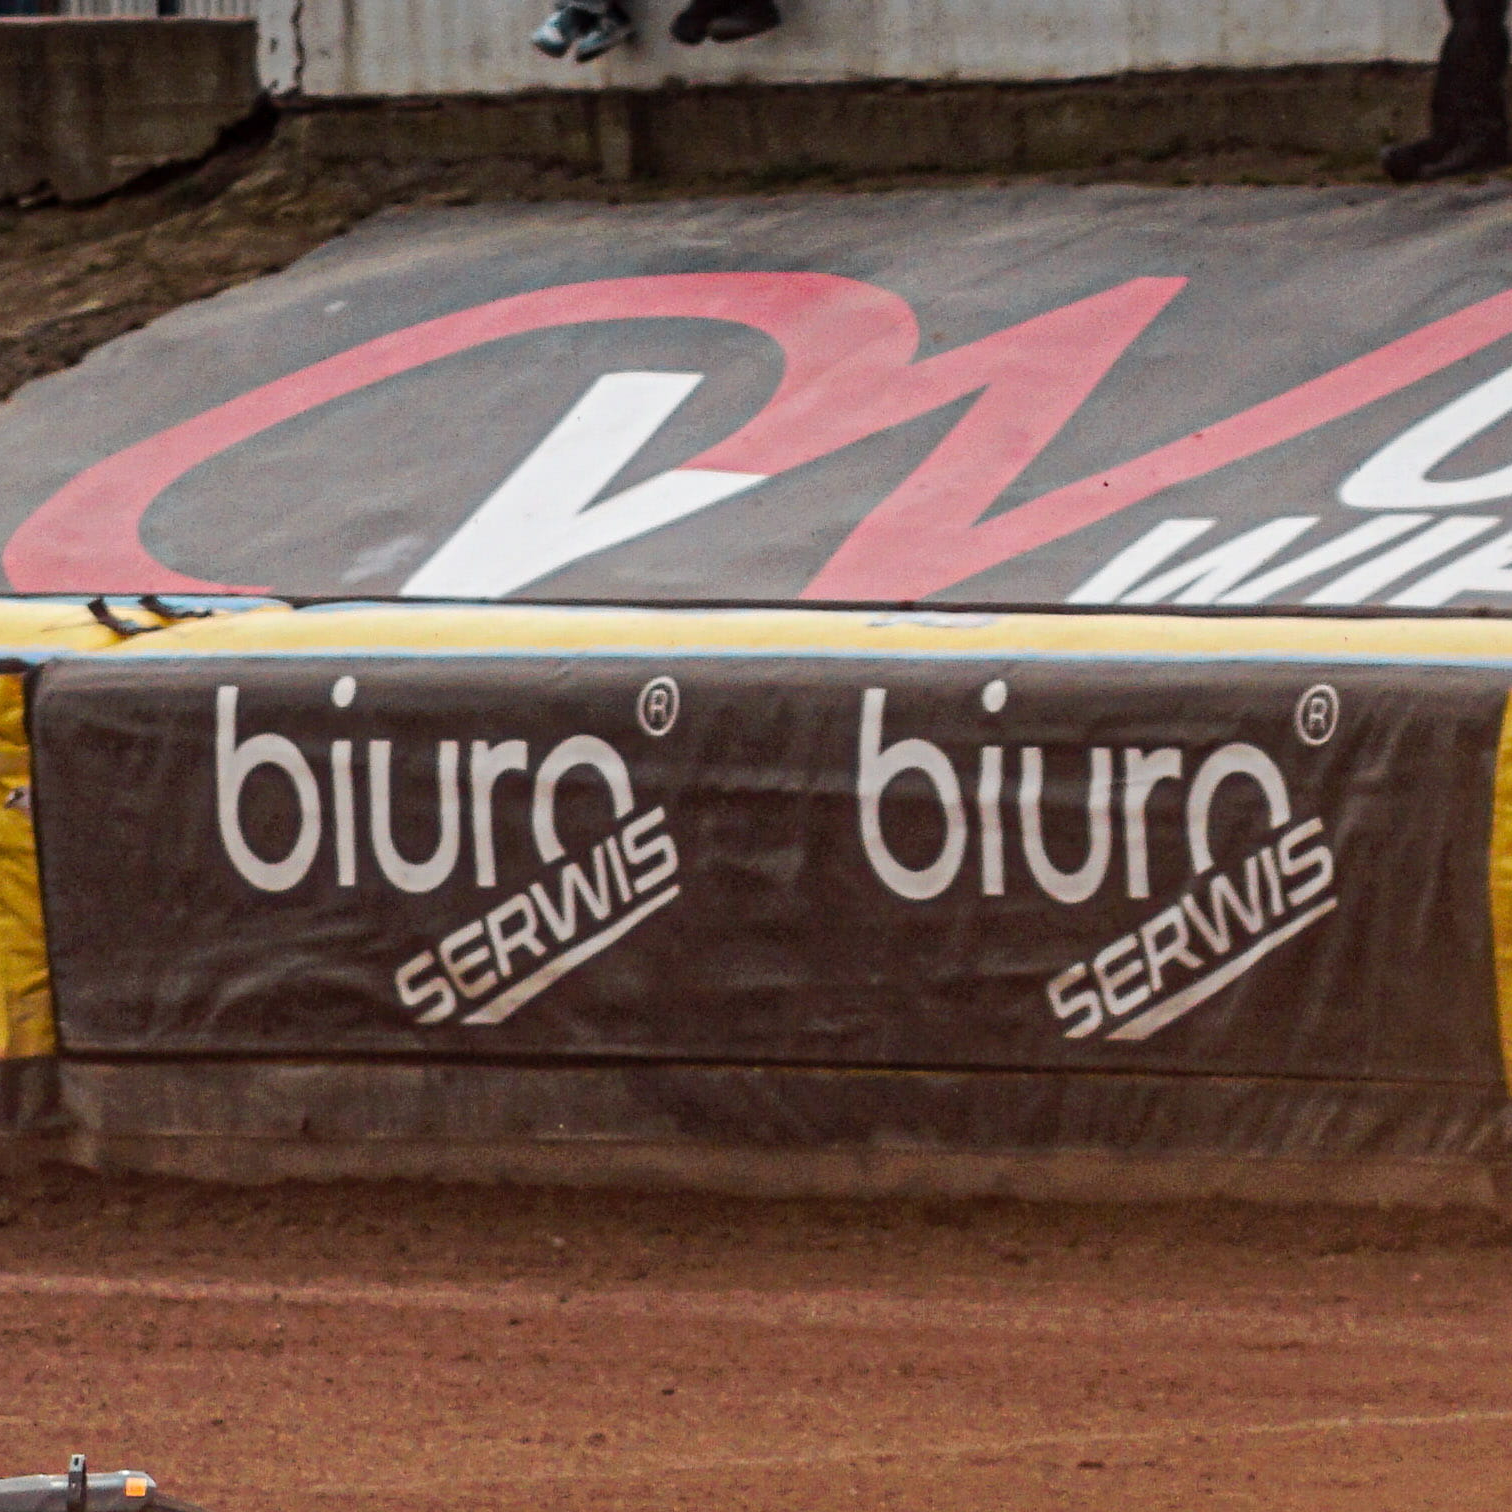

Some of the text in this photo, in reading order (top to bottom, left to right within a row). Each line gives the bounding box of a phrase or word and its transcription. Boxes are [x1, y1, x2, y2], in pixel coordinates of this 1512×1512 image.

[216, 675, 634, 893] biuro
[858, 679, 1290, 904] biuro
[395, 806, 680, 1023] SERWIS
[1047, 817, 1334, 1038] SERWIS
